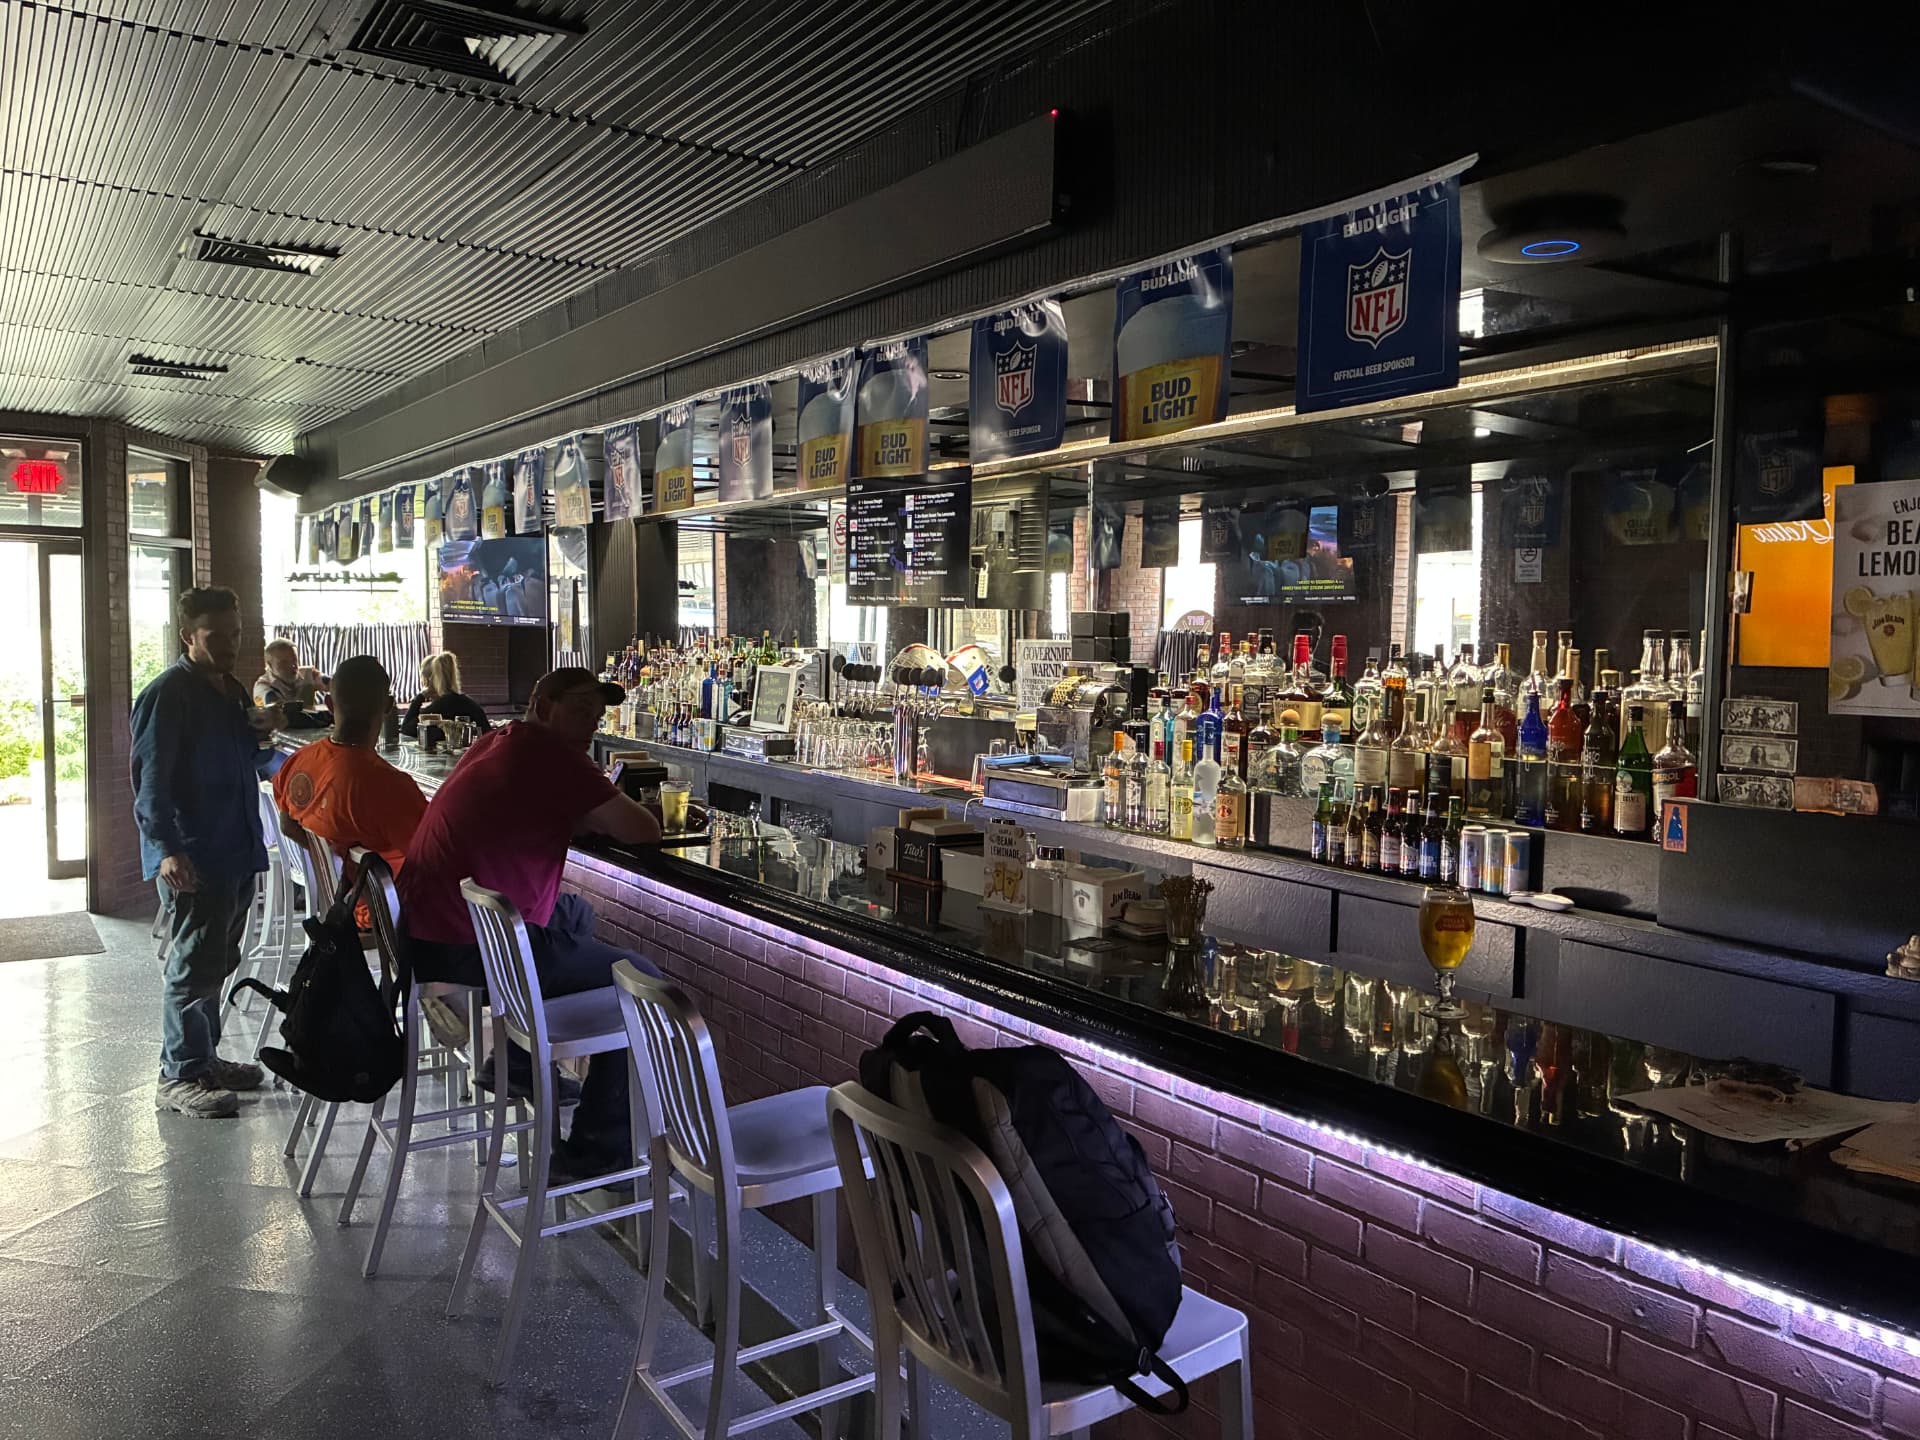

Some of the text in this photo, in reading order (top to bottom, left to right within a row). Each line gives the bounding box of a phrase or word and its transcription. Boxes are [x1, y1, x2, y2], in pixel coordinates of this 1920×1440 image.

[1343, 202, 1420, 238] BUD LIGHT
[1141, 264, 1199, 293] BUD LIGHT
[1353, 288, 1400, 333] NFL
[1333, 356, 1415, 381] OFFICIAL BEER SPONSOR
[1000, 372, 1029, 406] NFL
[1151, 377, 1191, 402] BUD
[1142, 396, 1198, 424] LIGHT
[881, 432, 907, 449] BUD
[815, 448, 835, 463] BUD
[874, 448, 911, 465] LIGHT
[18, 463, 58, 491] EXIT
[810, 461, 838, 478] LIGHT
[668, 477, 686, 489] BUD
[664, 488, 686, 502] LIGHT
[904, 843, 925, 858] Tito's
[990, 846, 1020, 859] LEMONADE
[1110, 888, 1141, 908] JIM BEAM
